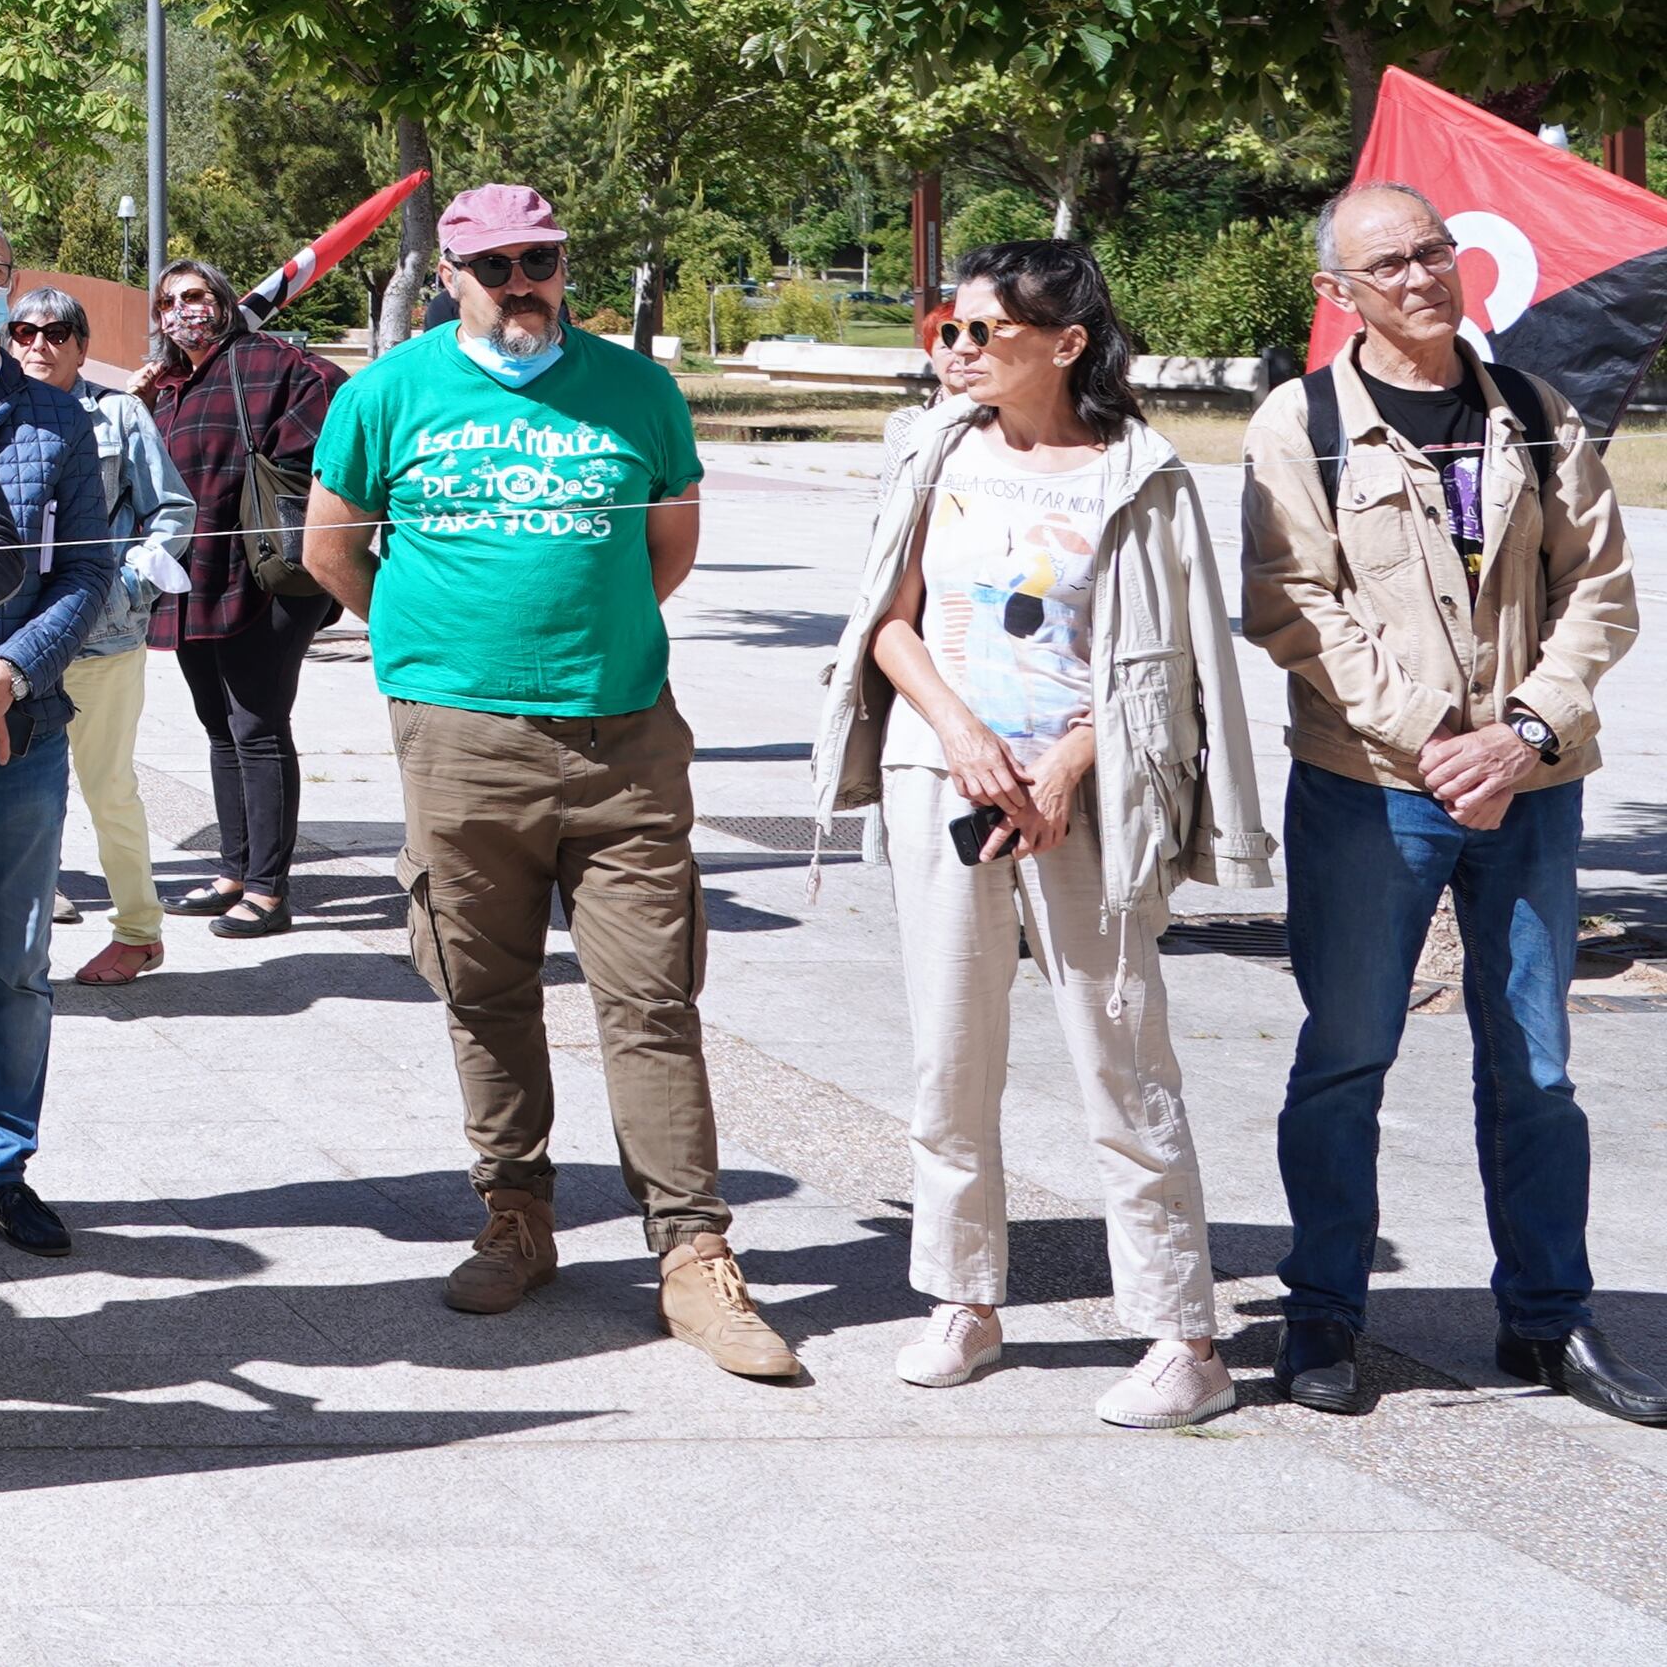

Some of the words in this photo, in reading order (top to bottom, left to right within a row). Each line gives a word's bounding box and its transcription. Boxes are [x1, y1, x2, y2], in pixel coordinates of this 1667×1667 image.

[525, 424, 617, 458] PÚBLICA
[422, 475, 468, 499] DE
[479, 464, 605, 503] TOD@S
[984, 478, 1025, 503] COSA
[1032, 487, 1065, 510] FAR
[419, 509, 497, 533] PARA
[503, 508, 612, 538] TOD@S
